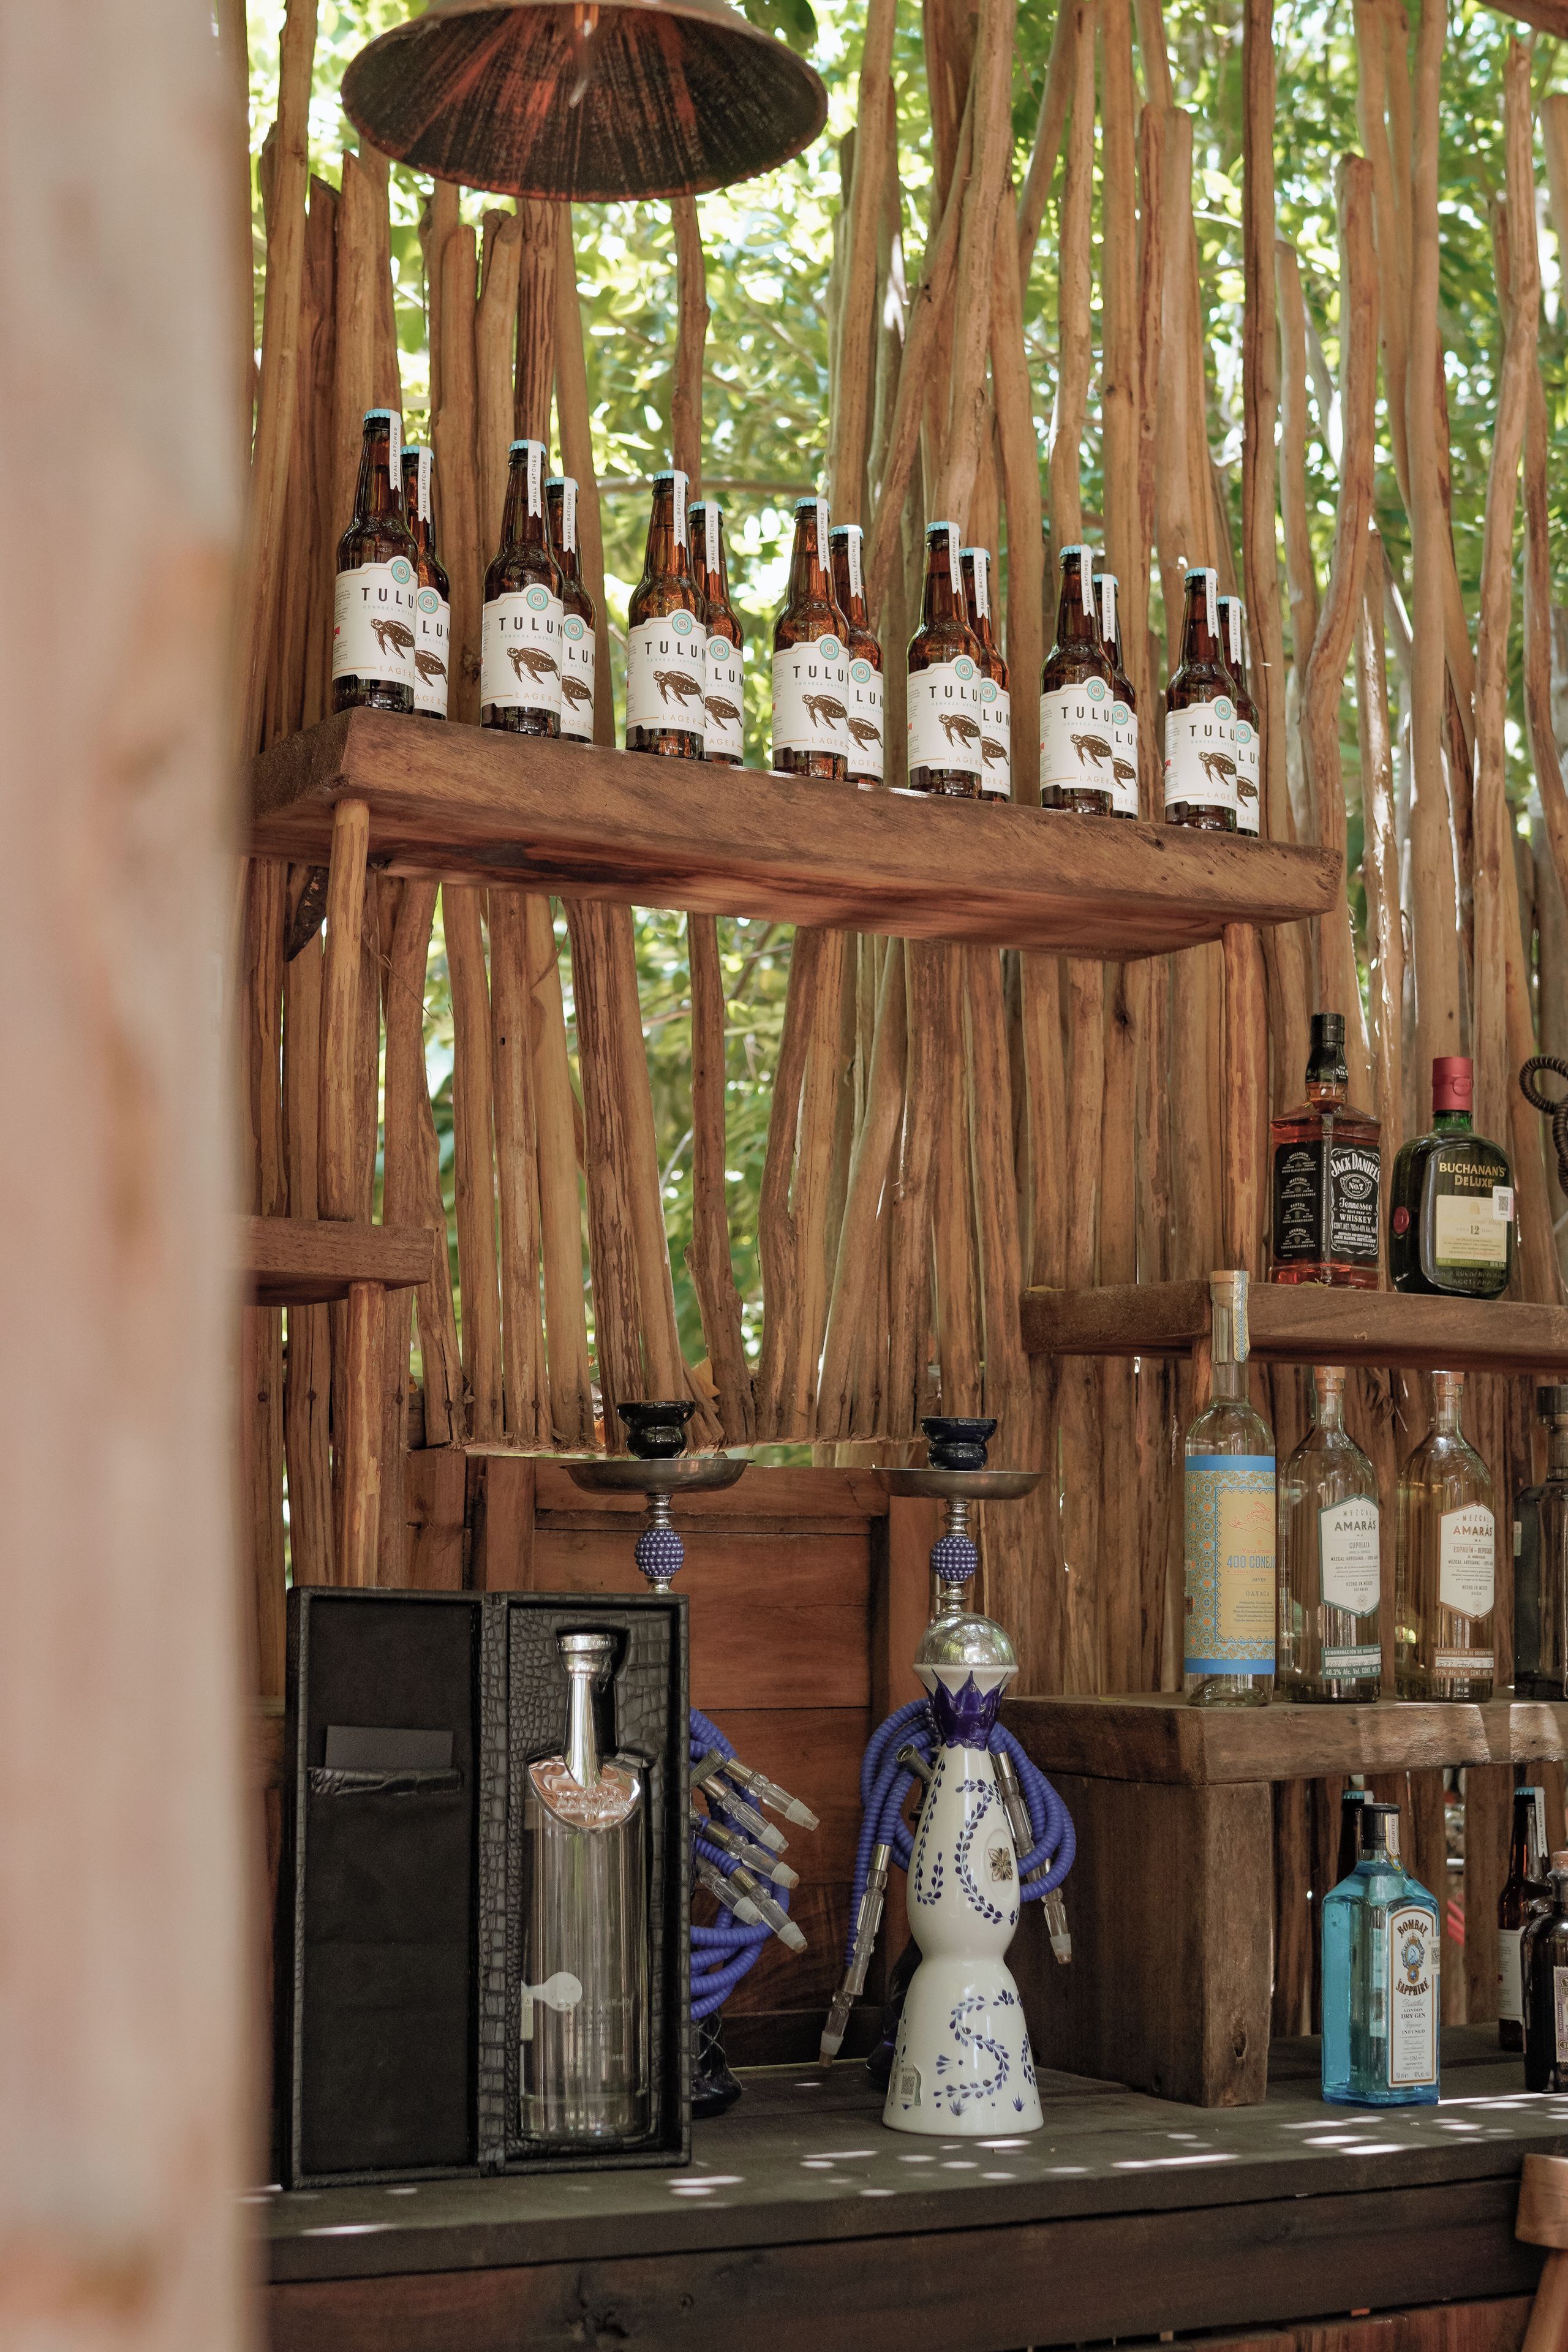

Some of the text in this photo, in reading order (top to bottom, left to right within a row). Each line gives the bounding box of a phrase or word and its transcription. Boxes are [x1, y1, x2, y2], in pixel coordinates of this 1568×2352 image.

[361, 587, 413, 609] TULU
[380, 665, 412, 677] LAGER
[793, 666, 848, 686] TULU
[929, 686, 979, 701] TULU
[415, 694, 441, 706] AGER
[663, 715, 696, 725] LAGER
[1061, 707, 1114, 725] TULU
[561, 720, 587, 729] AGER
[1189, 725, 1234, 741] TULU
[812, 737, 843, 747] LAGER
[851, 760, 876, 769] AGER
[949, 756, 979, 765] LAGER
[1079, 775, 1109, 784] LAGER
[1330, 1153, 1380, 1182] JACK DANIEL'S
[1439, 1163, 1505, 1177] BUCHANAN'S
[1339, 1197, 1372, 1211] Tennessee
[1340, 1214, 1371, 1224] WHISKEY
[1471, 1226, 1479, 1235] 12
[1335, 1518, 1376, 1531] AMARÁS
[1453, 1524, 1492, 1536] AMARÁS
[1227, 1556, 1275, 1568] 400 CONEJO
[1397, 1919, 1428, 1938] BOMBAY
[1396, 1977, 1430, 1996] SAPPHIRE
